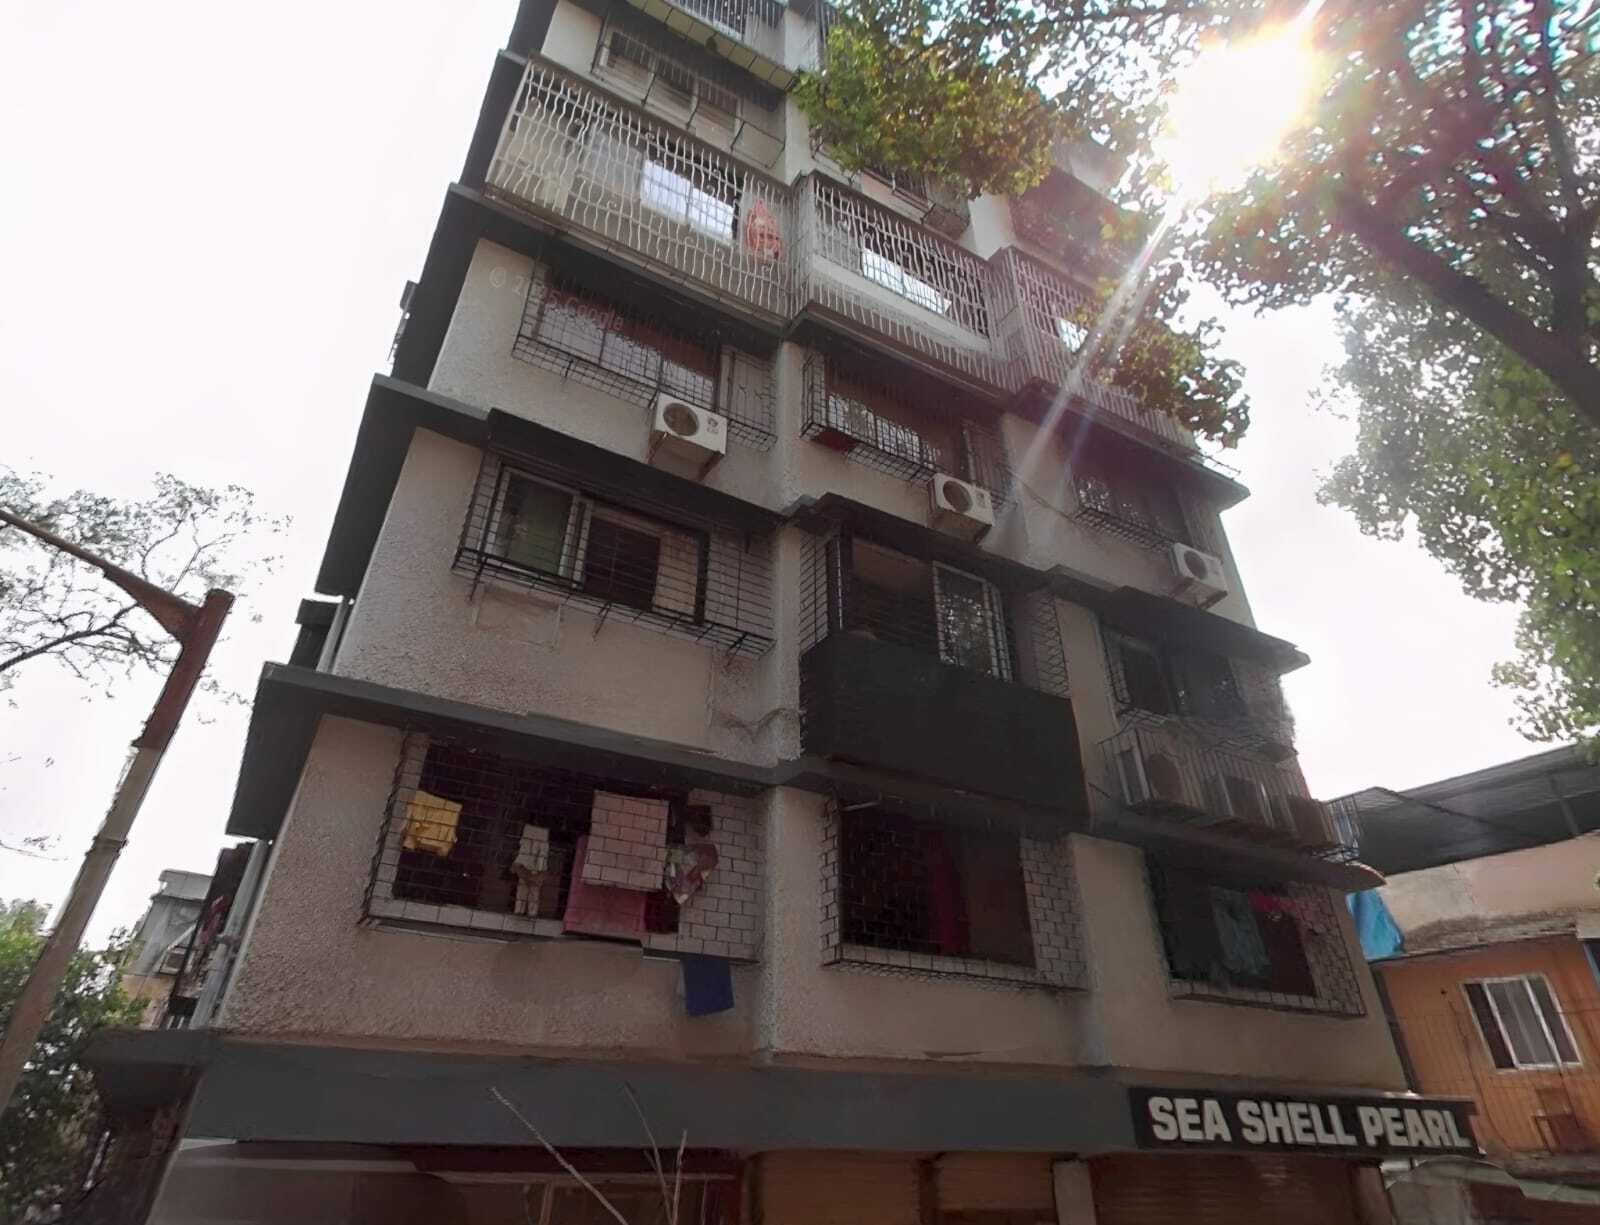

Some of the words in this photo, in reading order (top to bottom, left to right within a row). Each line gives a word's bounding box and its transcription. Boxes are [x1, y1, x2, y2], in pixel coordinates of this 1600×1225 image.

[1148, 1096, 1232, 1142] SEA
[1236, 1100, 1358, 1146] SHELL
[1357, 1105, 1474, 1148] PEARL
